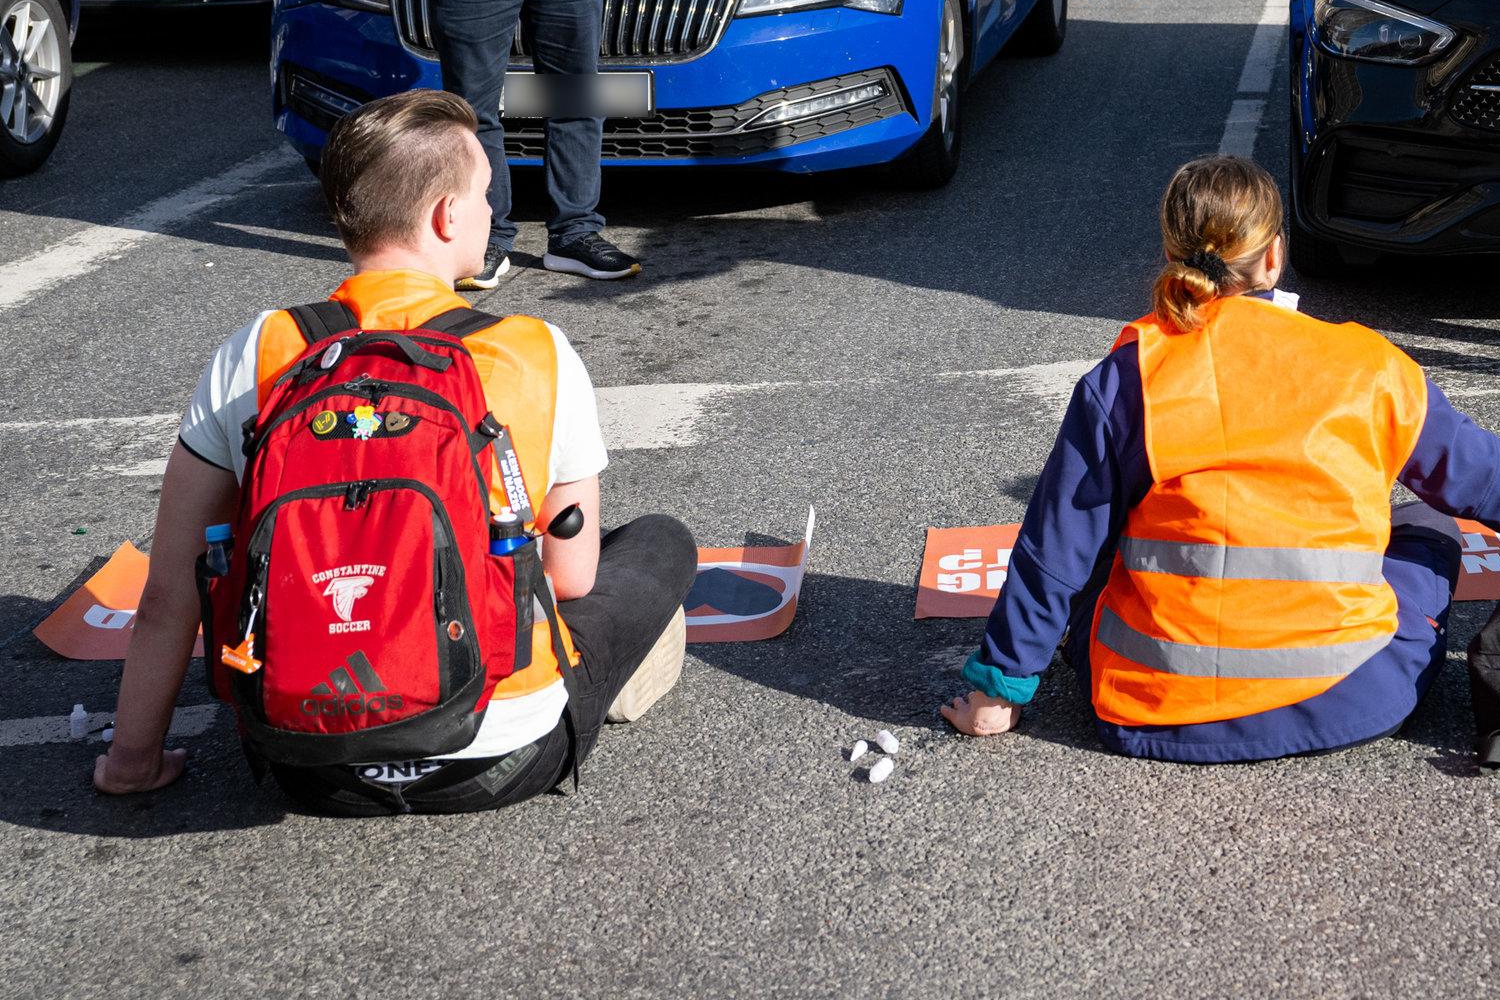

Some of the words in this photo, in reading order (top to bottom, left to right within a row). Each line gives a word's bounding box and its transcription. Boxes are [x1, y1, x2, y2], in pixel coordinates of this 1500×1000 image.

[311, 564, 387, 584] CONSTANTINE
[328, 620, 371, 634] SOCCER
[301, 693, 404, 715] adidas
